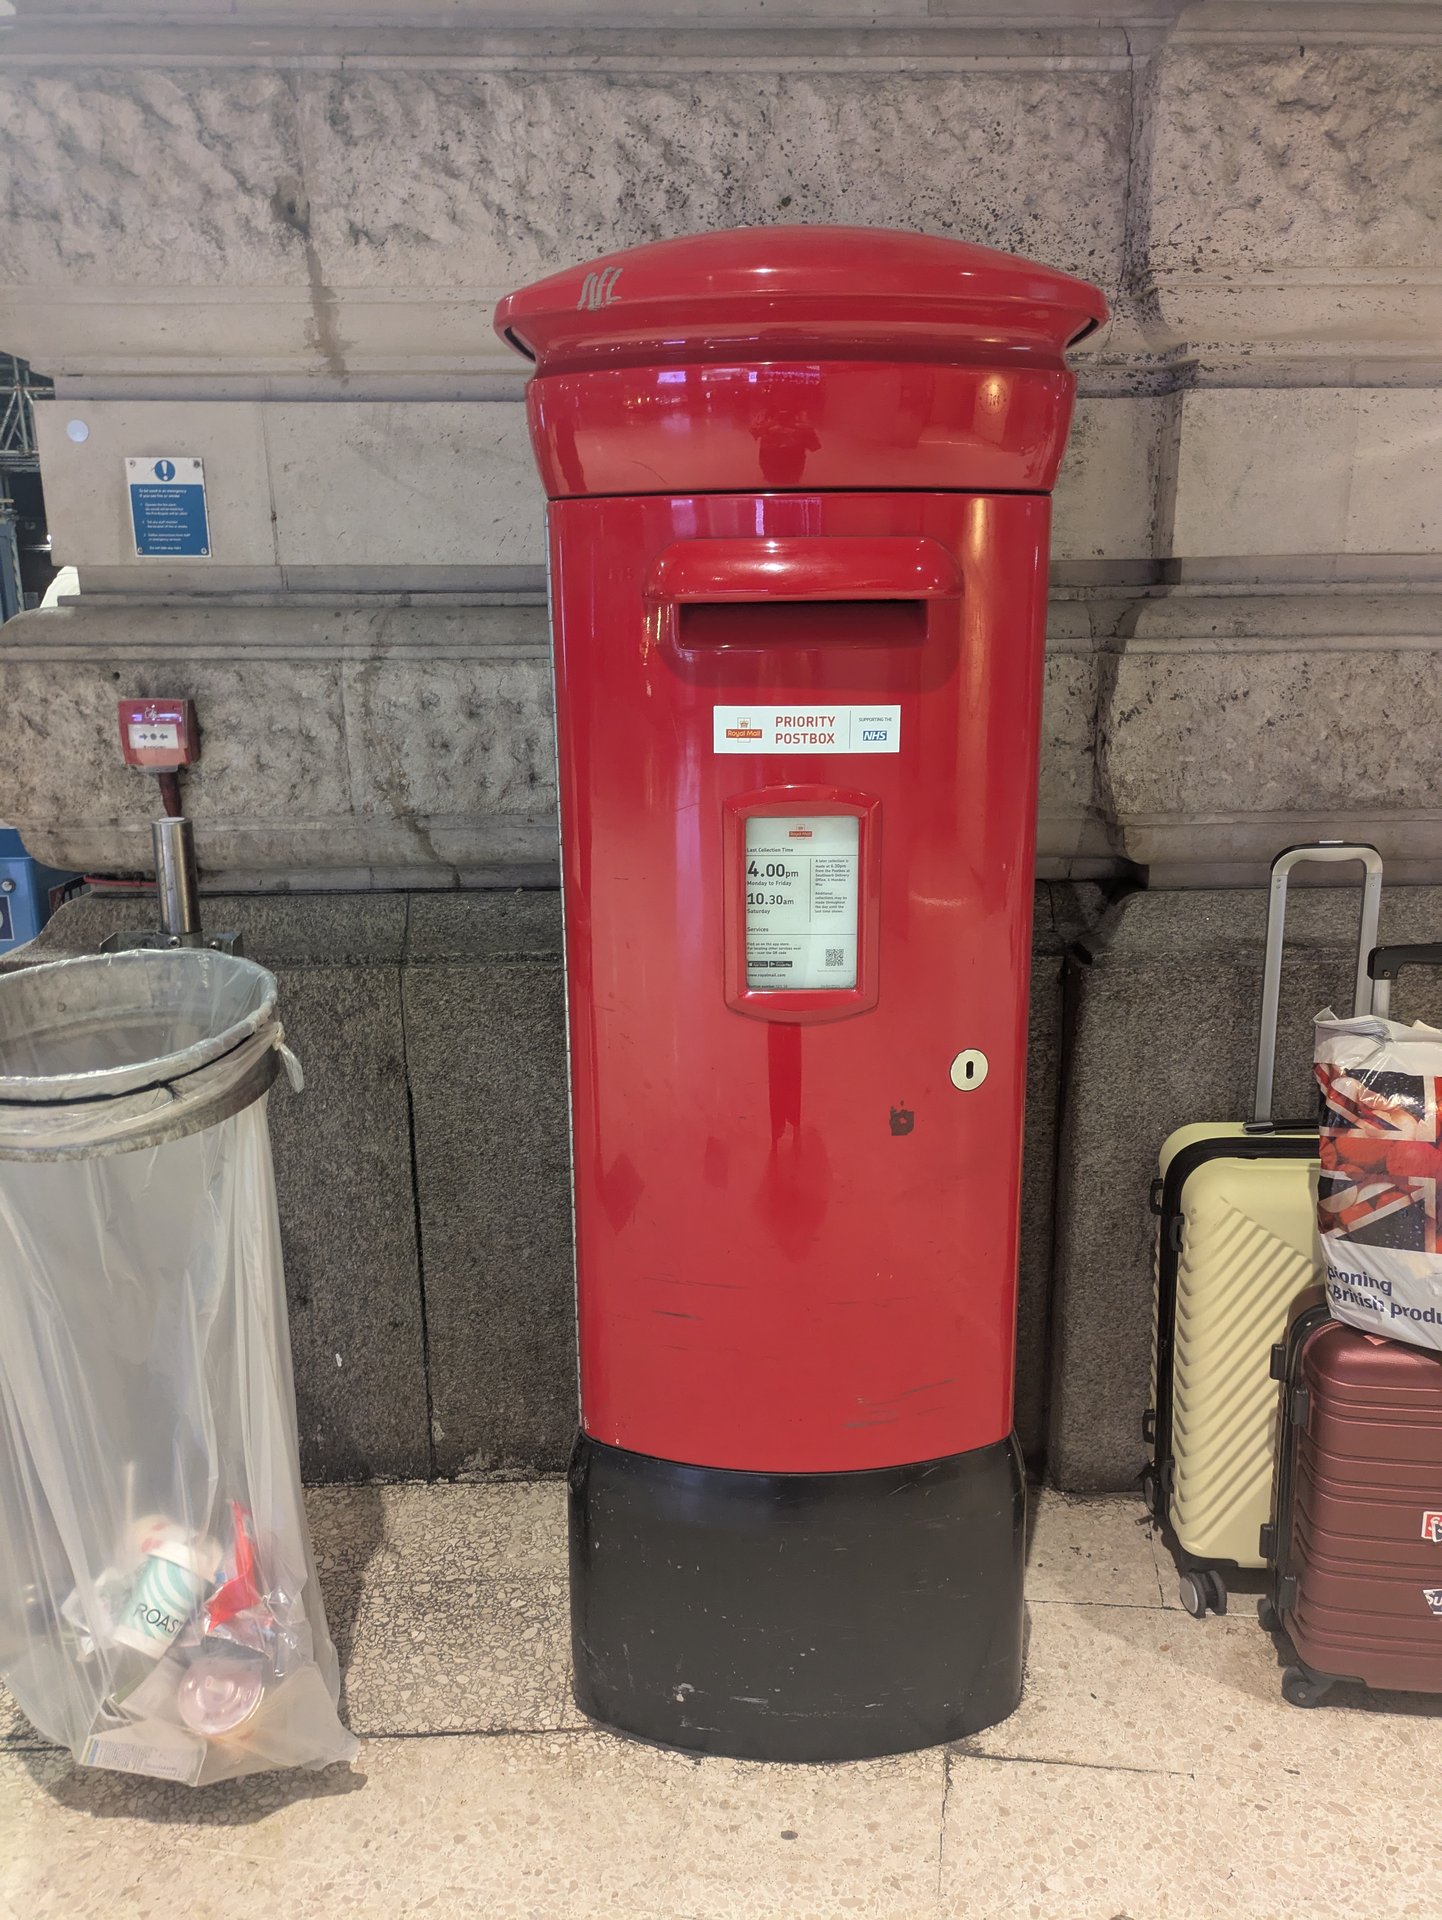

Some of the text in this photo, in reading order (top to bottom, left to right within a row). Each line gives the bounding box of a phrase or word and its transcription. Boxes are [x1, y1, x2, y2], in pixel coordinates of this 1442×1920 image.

[775, 716, 835, 727] PRIORITY
[728, 729, 745, 737] Royal
[775, 733, 835, 744] POSTBOX
[864, 731, 887, 740] NHS
[747, 860, 799, 878] 4.00pm
[747, 893, 794, 905] 10.30am
[1333, 1285, 1385, 1312] British
